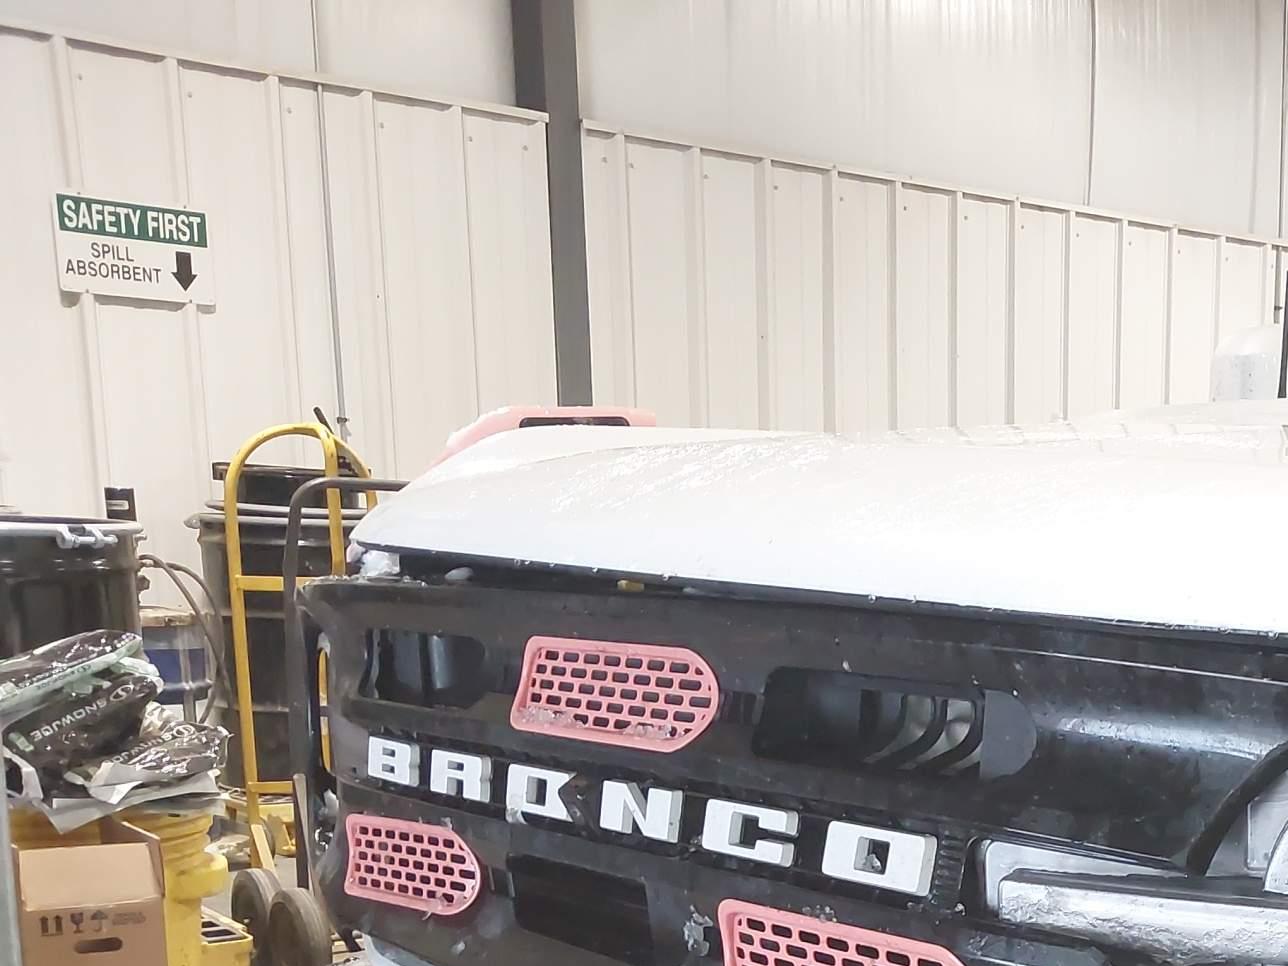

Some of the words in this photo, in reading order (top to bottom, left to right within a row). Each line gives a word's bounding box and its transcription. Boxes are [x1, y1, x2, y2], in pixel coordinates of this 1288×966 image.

[62, 198, 141, 236] SAFETY
[147, 209, 202, 243] FIRST
[65, 259, 162, 284] ABSORBENT
[90, 242, 135, 262] SPILL
[29, 698, 108, 742] SNOWJOE
[368, 735, 938, 897] BRONCO
